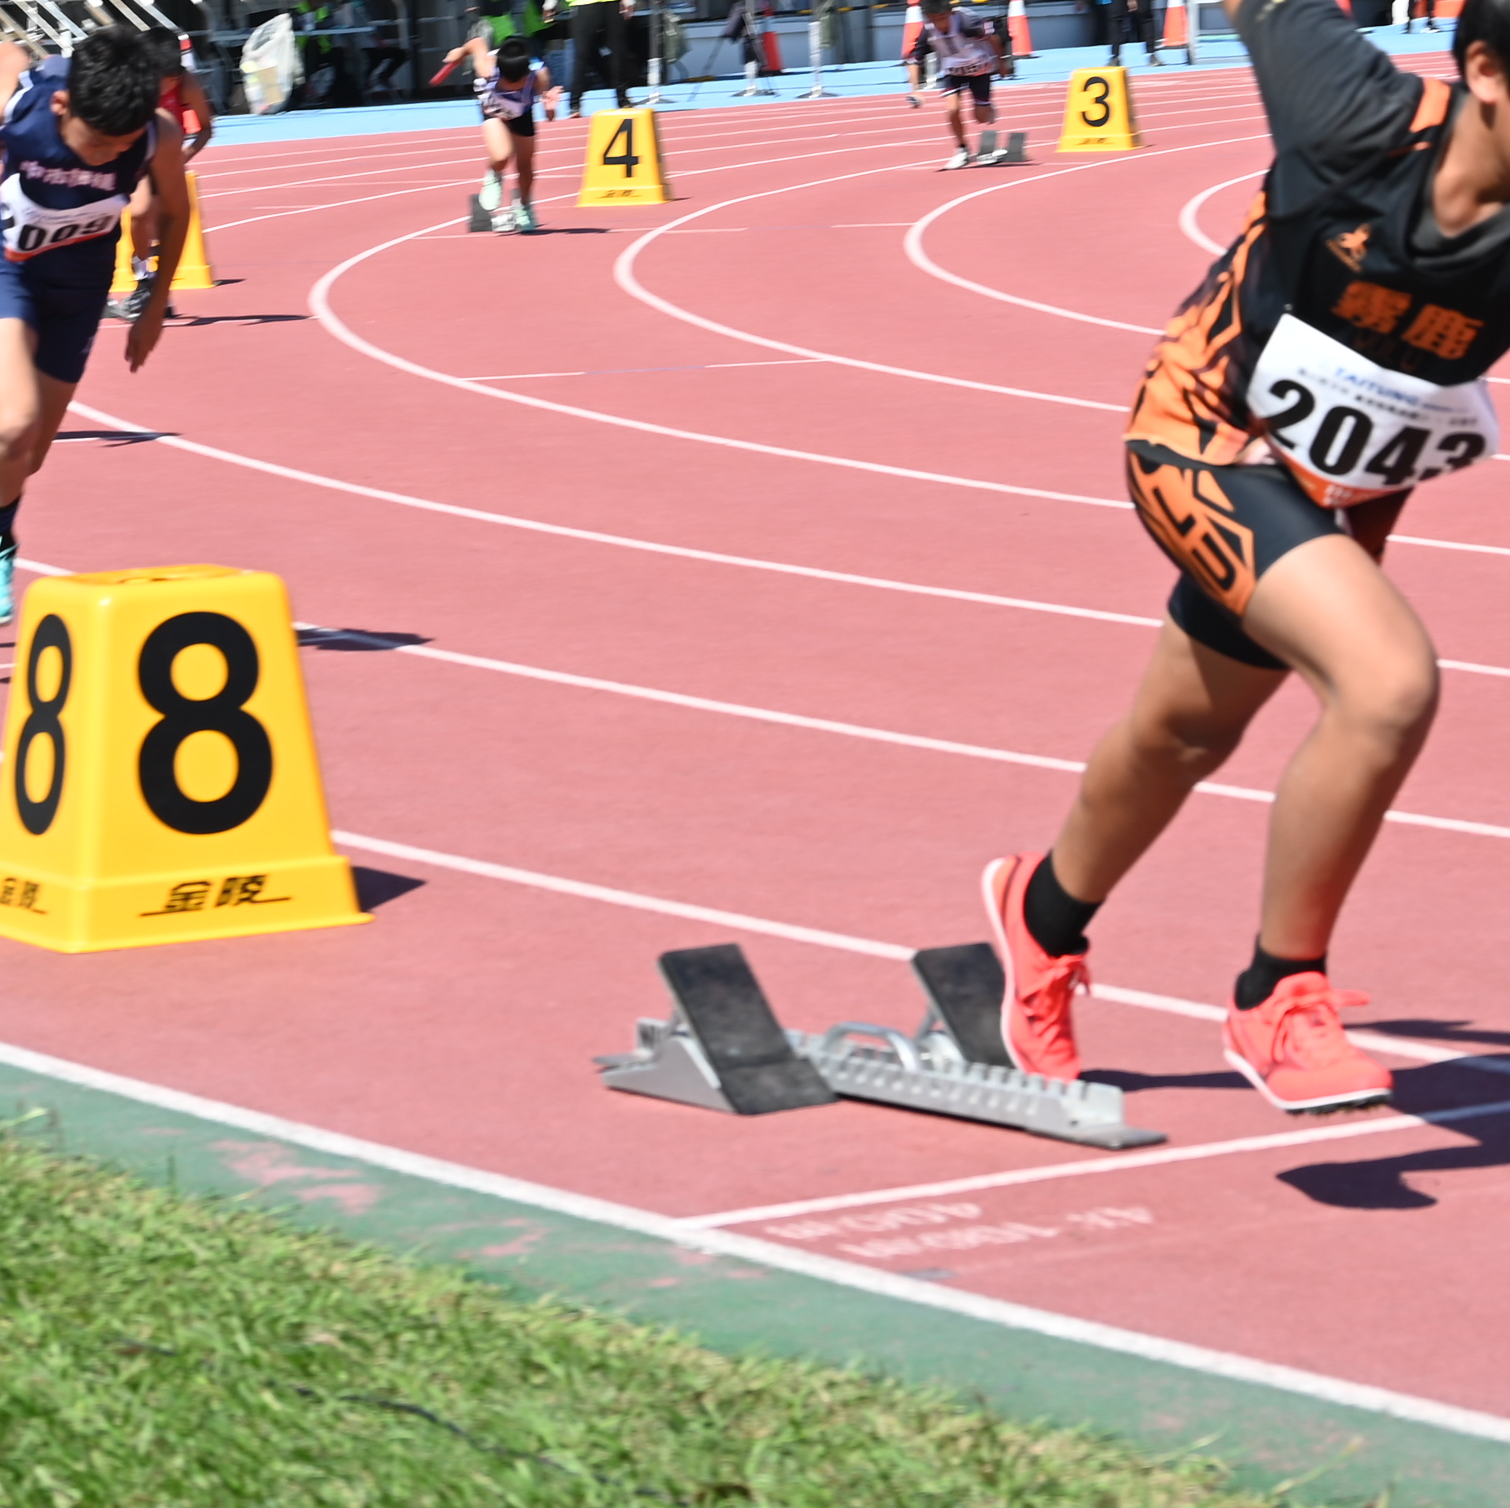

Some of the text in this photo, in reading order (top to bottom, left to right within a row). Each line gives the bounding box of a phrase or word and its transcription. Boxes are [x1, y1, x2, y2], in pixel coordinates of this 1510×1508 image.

[1081, 76, 1111, 128] 3
[602, 118, 640, 178] 4
[1268, 378, 1487, 487] 2043
[15, 613, 73, 836] 8
[137, 611, 273, 835] 8
[155, 874, 277, 916] 金陵
